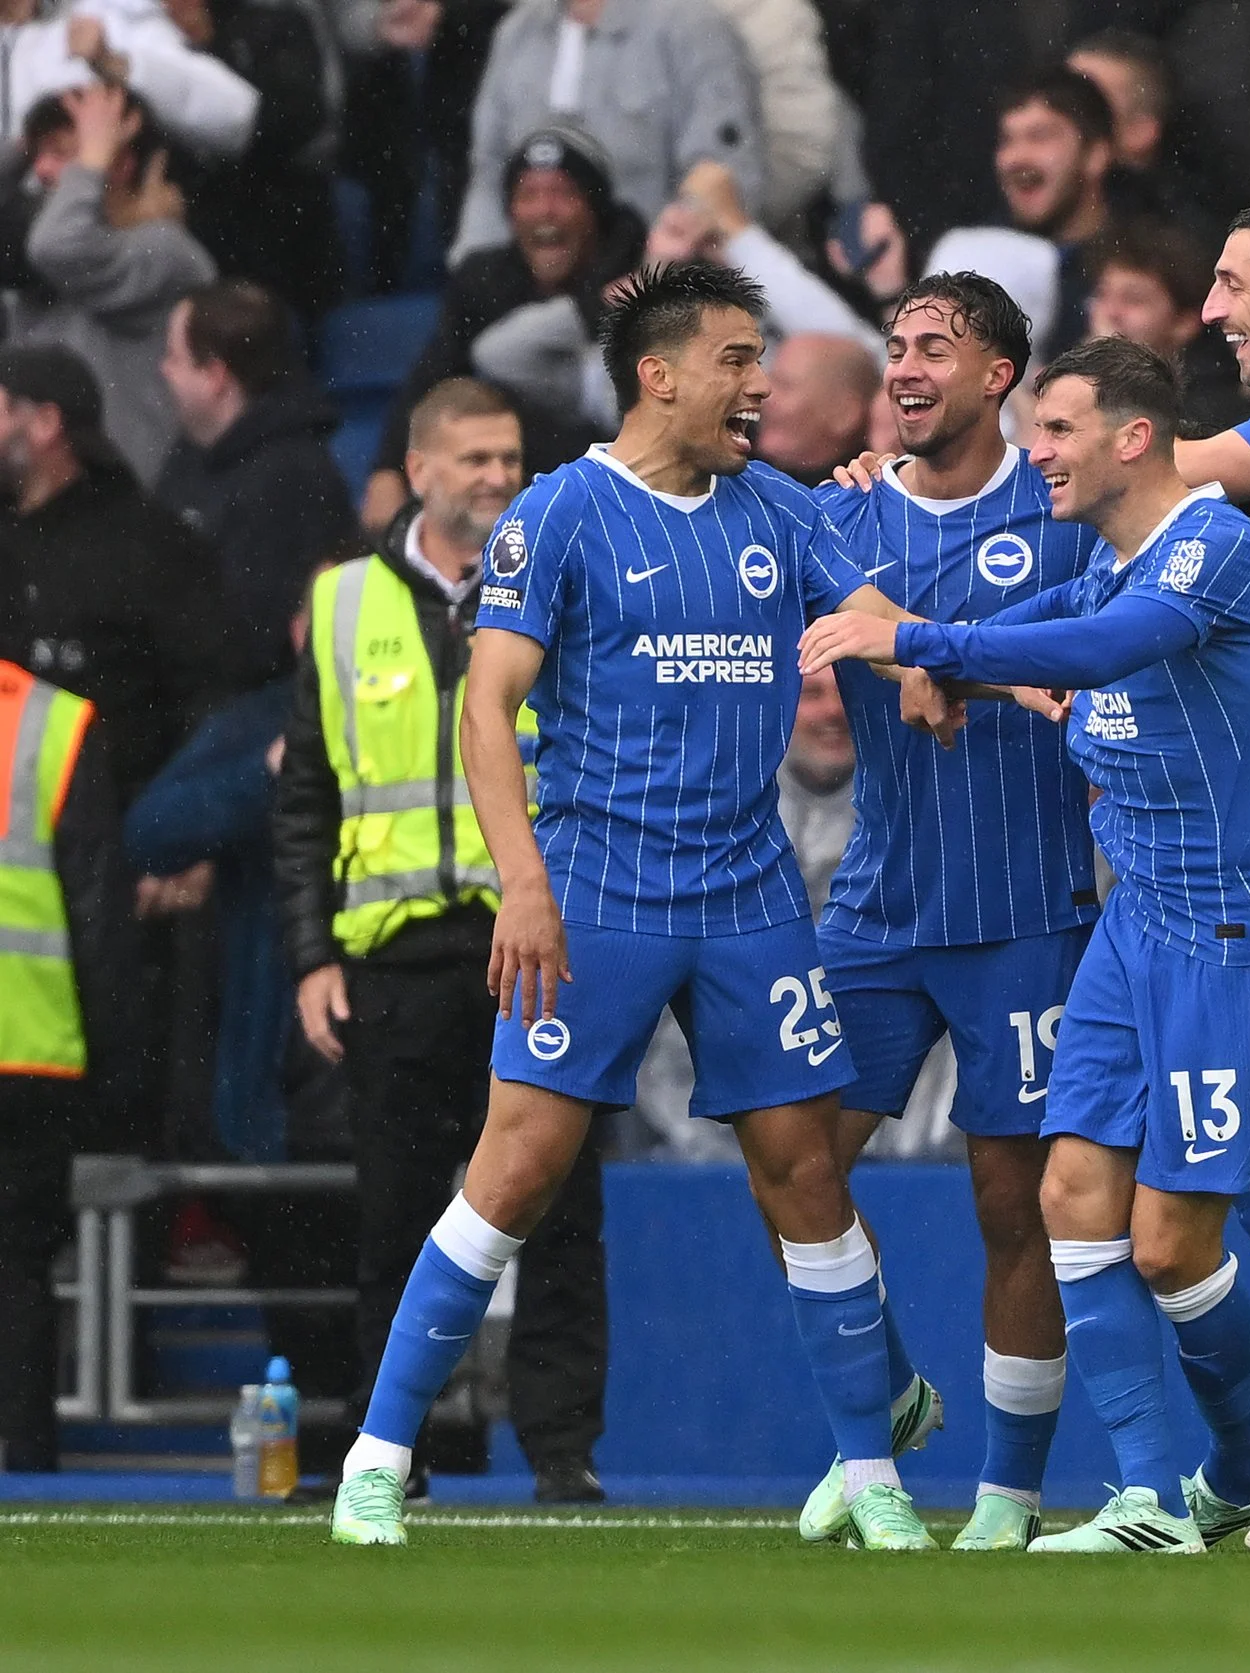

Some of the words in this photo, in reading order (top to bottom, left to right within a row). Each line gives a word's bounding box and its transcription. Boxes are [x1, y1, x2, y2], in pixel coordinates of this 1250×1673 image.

[631, 634, 772, 657] AMERICAN
[656, 660, 774, 683] EXPRESS
[769, 966, 842, 1051] 25
[1170, 1069, 1241, 1142] 13
